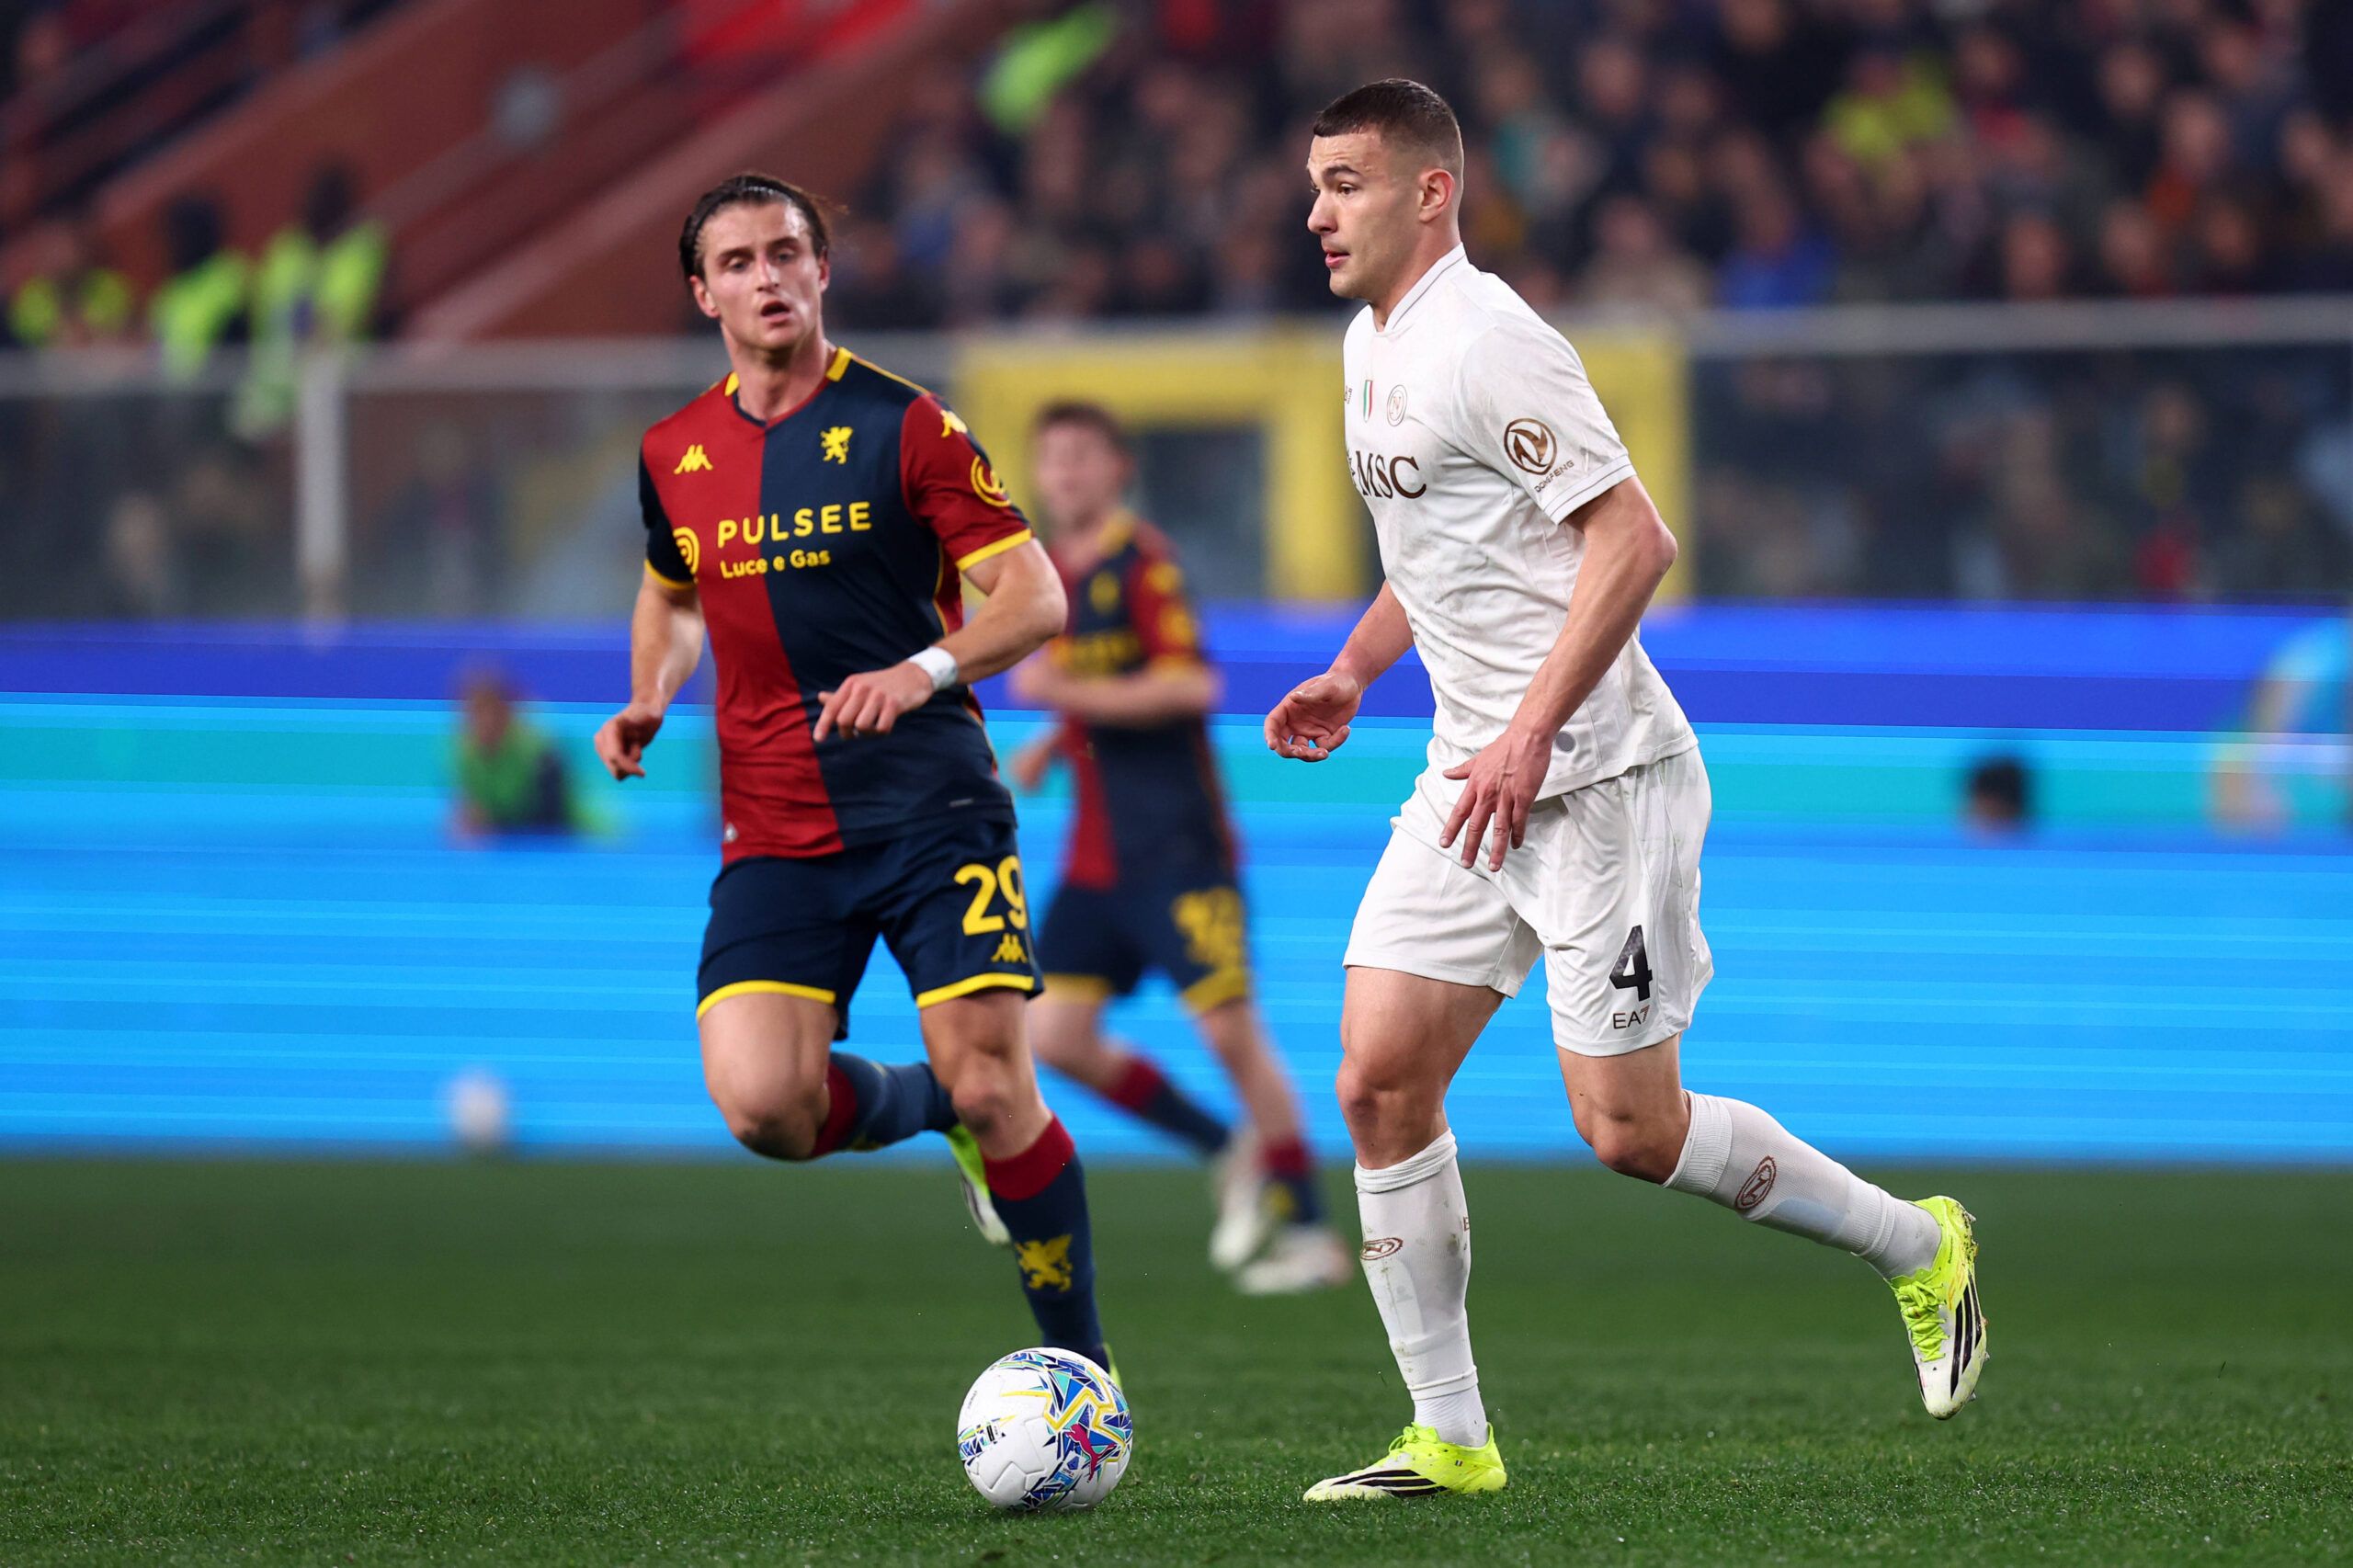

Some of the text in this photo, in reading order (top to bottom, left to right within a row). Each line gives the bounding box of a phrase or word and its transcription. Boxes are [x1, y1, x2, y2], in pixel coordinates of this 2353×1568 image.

[1355, 449, 1427, 499] MSC
[717, 501, 872, 549] PULSEE
[720, 549, 831, 579] Luce e Gas
[953, 855, 1028, 936] 29
[1608, 925, 1654, 1002] 4
[1613, 1005, 1651, 1029] EA7
